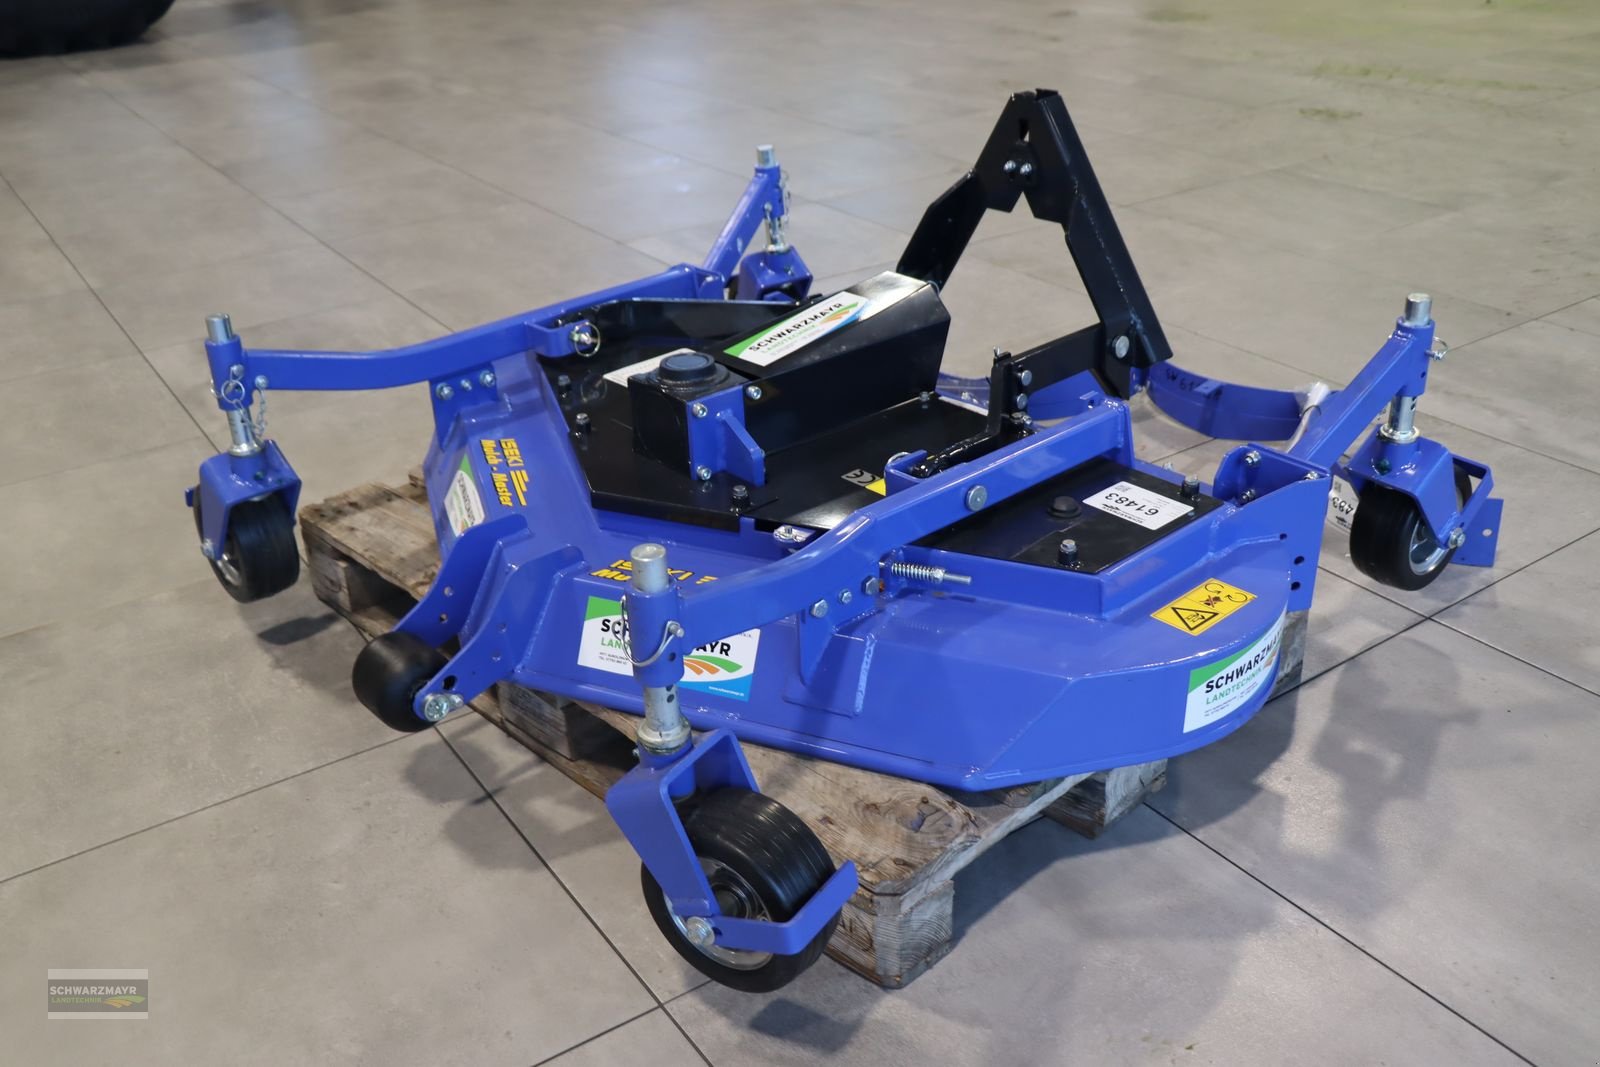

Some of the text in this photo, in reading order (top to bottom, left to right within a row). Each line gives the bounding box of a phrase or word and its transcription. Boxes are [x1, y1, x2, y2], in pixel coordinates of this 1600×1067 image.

[748, 302, 843, 352] SCHWARZMAYR
[480, 439, 503, 465] Mulch
[499, 438, 524, 467] ISEKI
[490, 472, 513, 507] Master
[1104, 492, 1160, 517] 61483
[1333, 496, 1354, 515] 483
